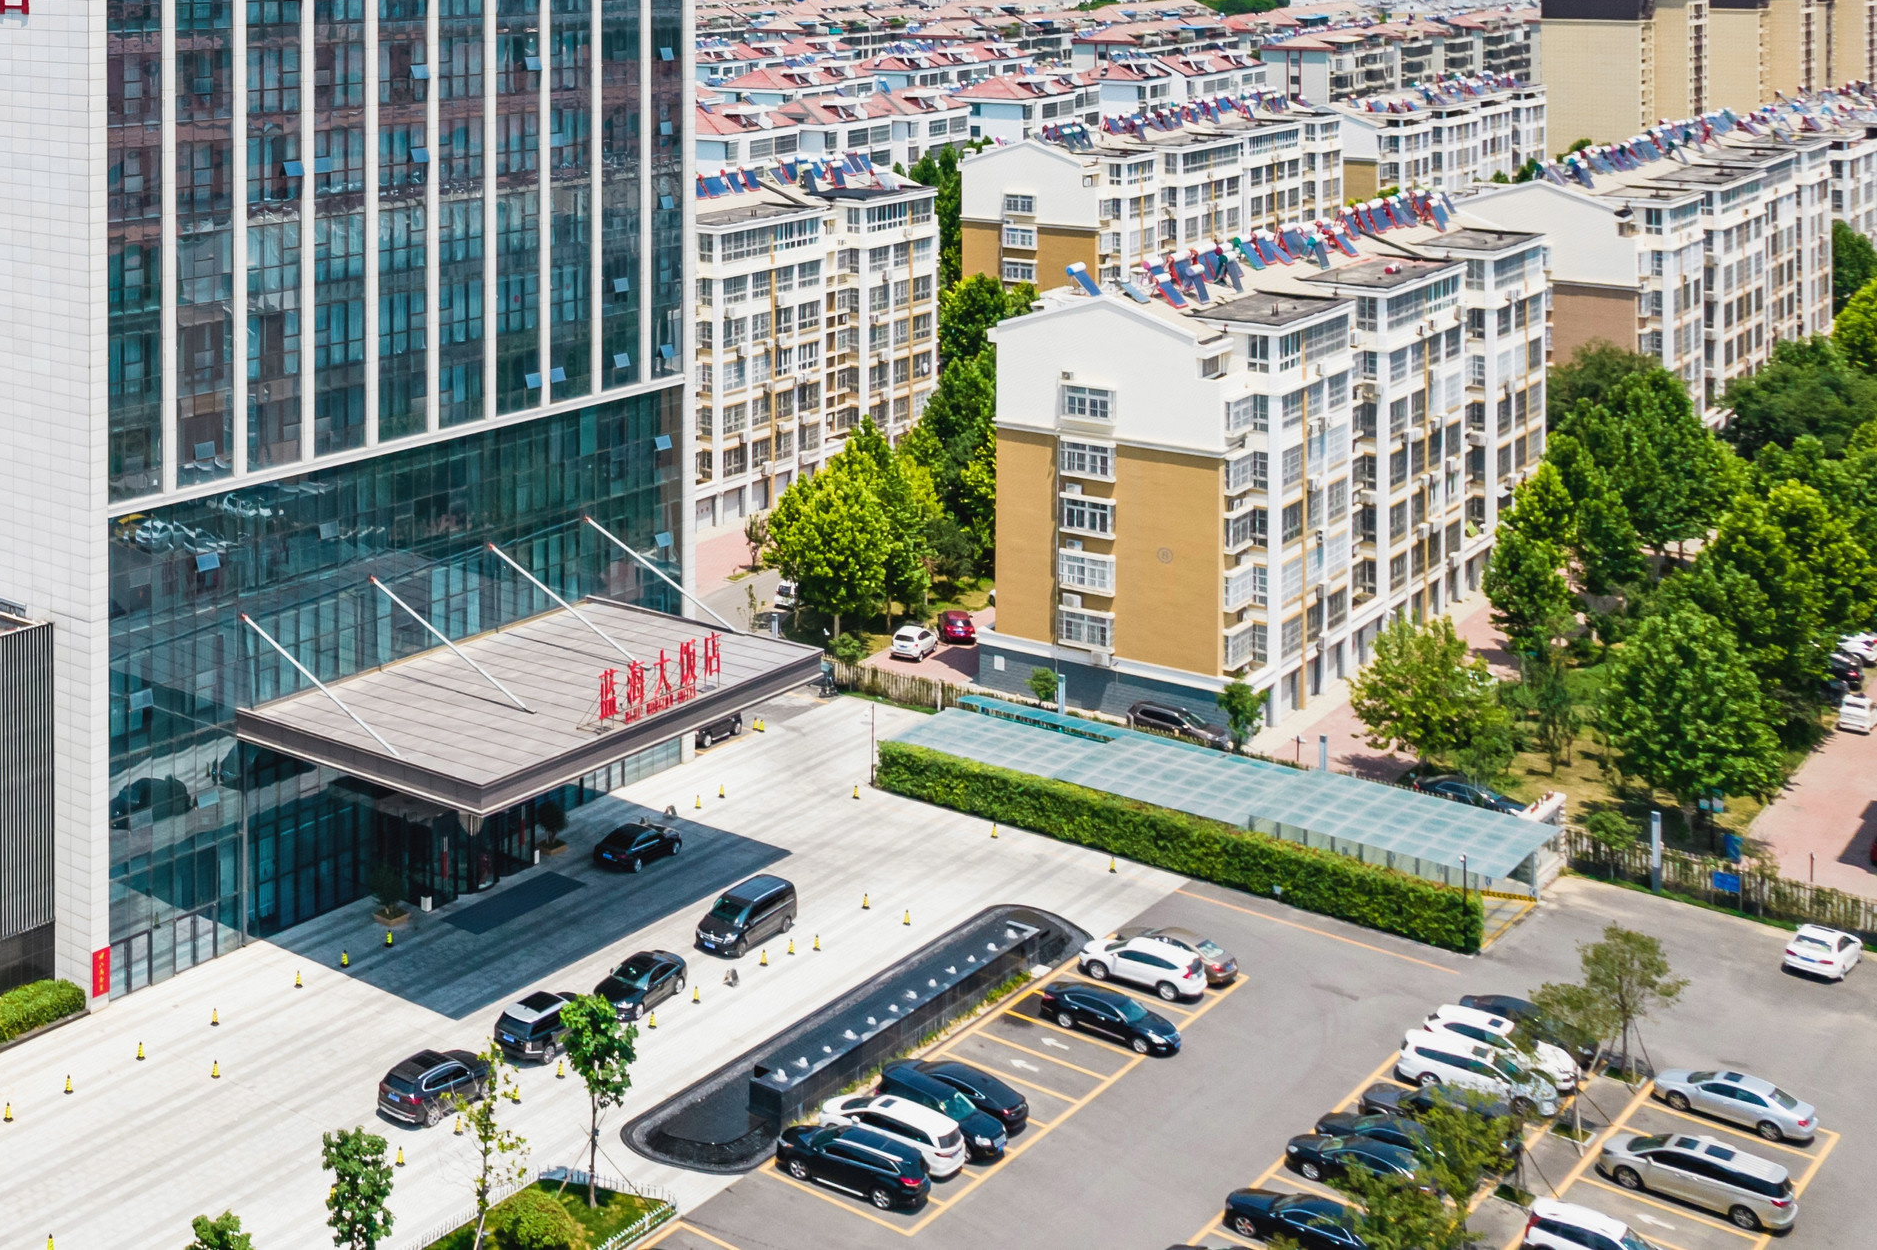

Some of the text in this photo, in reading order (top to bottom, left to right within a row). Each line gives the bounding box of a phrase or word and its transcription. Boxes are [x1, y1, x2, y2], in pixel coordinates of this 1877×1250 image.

[598, 631, 722, 720] 蓝海大饭店
